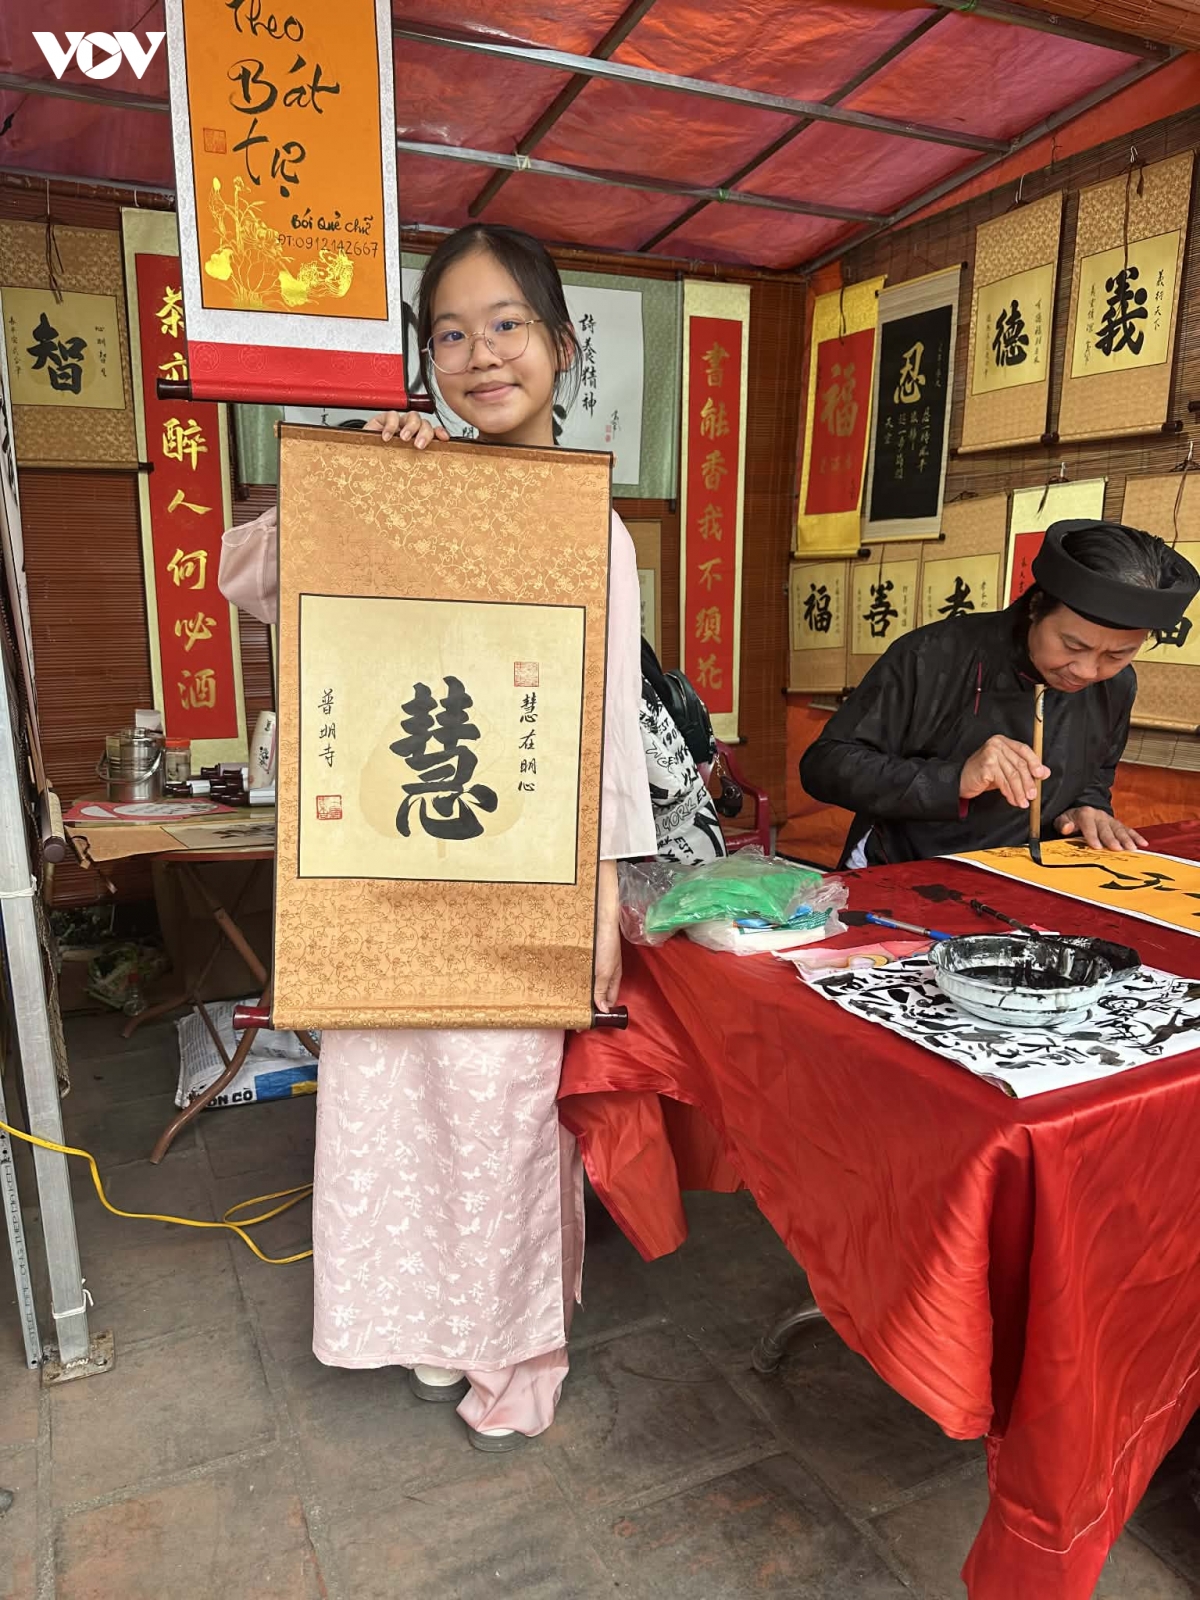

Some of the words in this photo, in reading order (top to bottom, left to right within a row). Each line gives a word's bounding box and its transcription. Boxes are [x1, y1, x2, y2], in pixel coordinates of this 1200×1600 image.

[227, 54, 340, 115] Bát
[1094, 266, 1148, 356] 義
[26, 312, 88, 395] 智
[893, 341, 926, 404] 忍
[803, 583, 833, 634] 福
[862, 580, 898, 638] 善
[388, 675, 498, 841] 慧
[518, 692, 538, 792] 慧在明心
